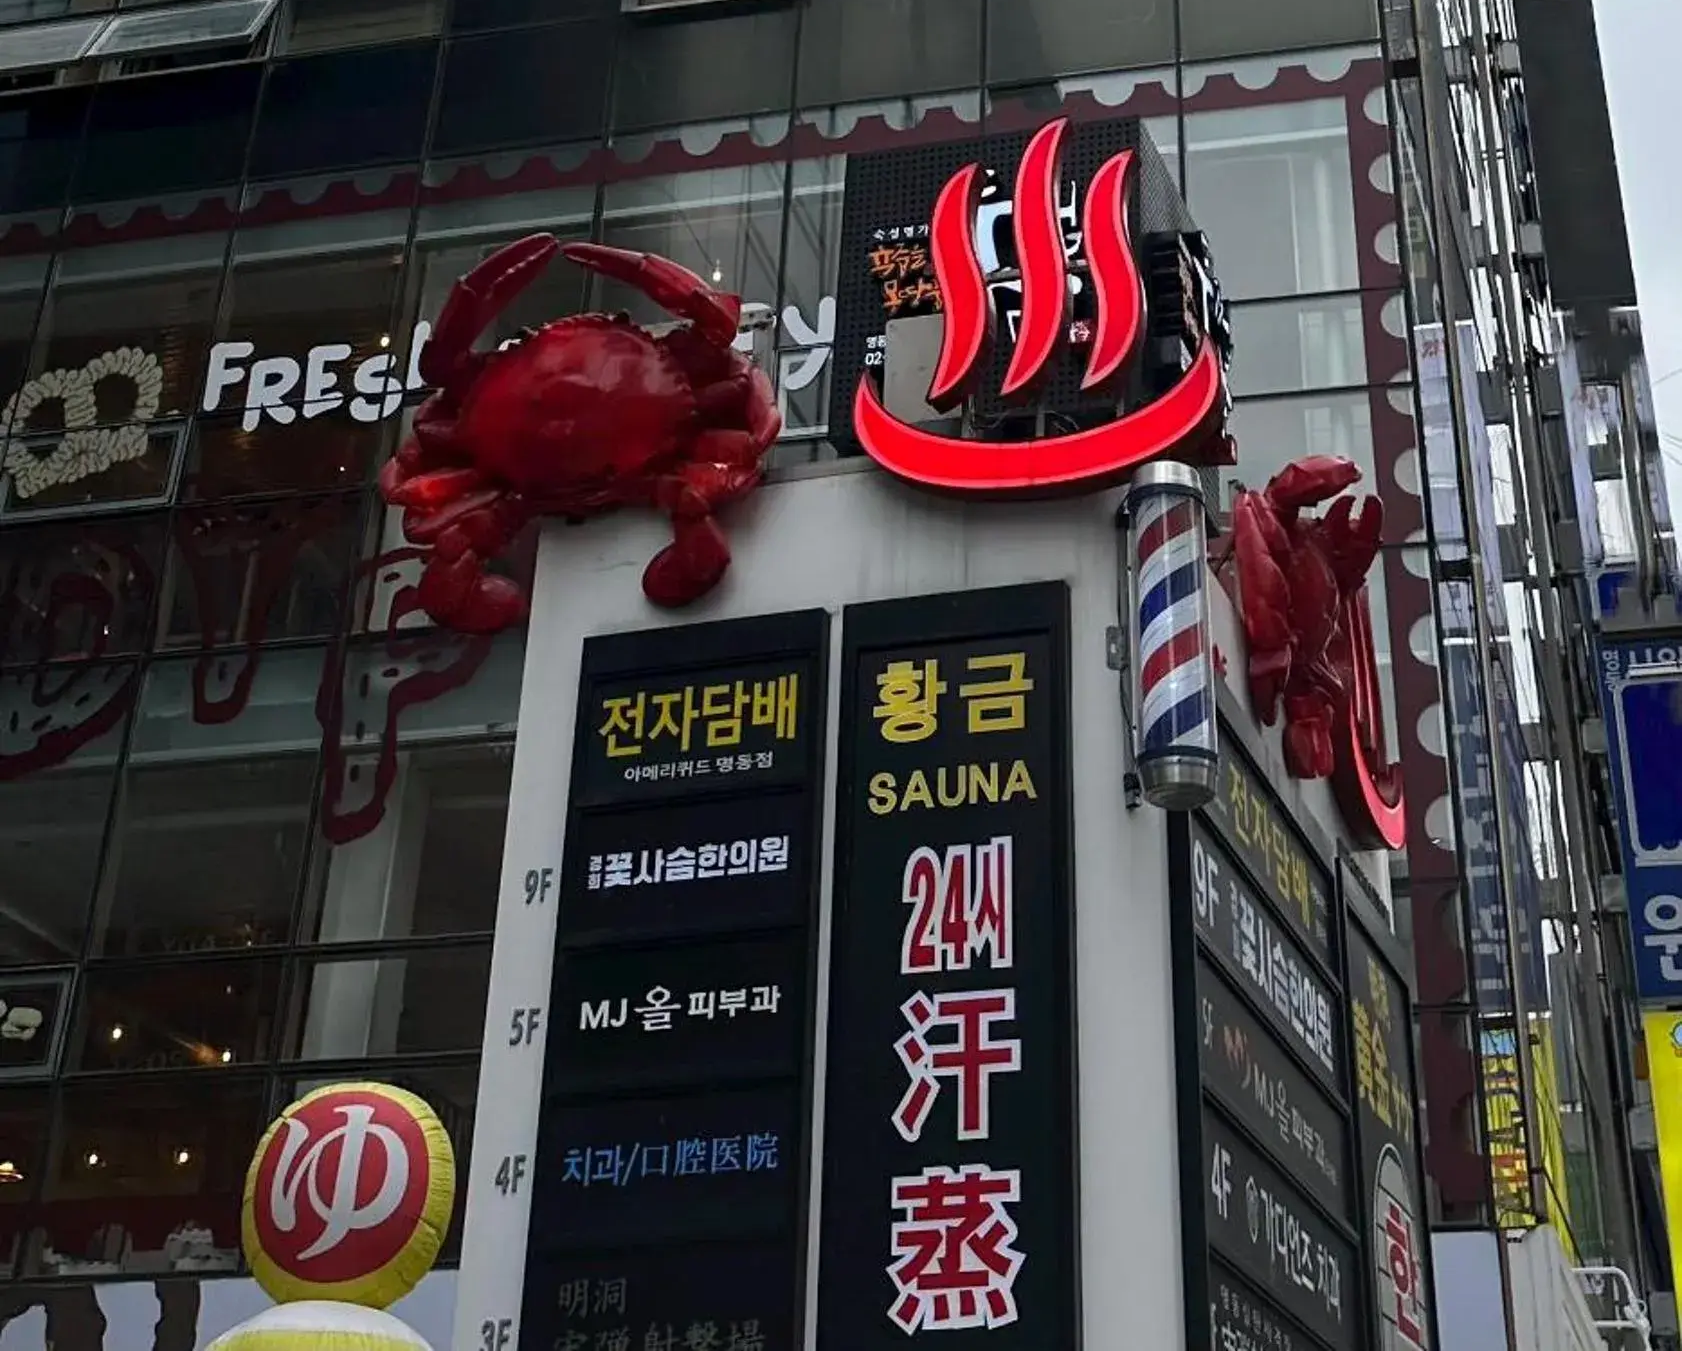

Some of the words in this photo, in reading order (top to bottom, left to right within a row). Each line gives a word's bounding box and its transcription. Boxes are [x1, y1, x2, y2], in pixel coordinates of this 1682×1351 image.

[599, 672, 800, 760] 전자담배
[872, 651, 1036, 746] 황금
[716, 751, 774, 774] 명동점
[867, 760, 1038, 817] SAUNA
[1228, 761, 1311, 931] 전자담배
[525, 867, 554, 905] 9F
[899, 835, 1014, 975] 24시
[1193, 839, 1220, 927] 9F
[510, 1007, 542, 1046] 5F
[579, 997, 628, 1032] MJ
[633, 986, 682, 1032] 올
[688, 985, 783, 1021] 피부과
[270, 1104, 410, 1261] ゆ
[495, 1155, 526, 1195] 4F
[1210, 1141, 1234, 1220] 4F
[556, 1277, 629, 1320] 明洞
